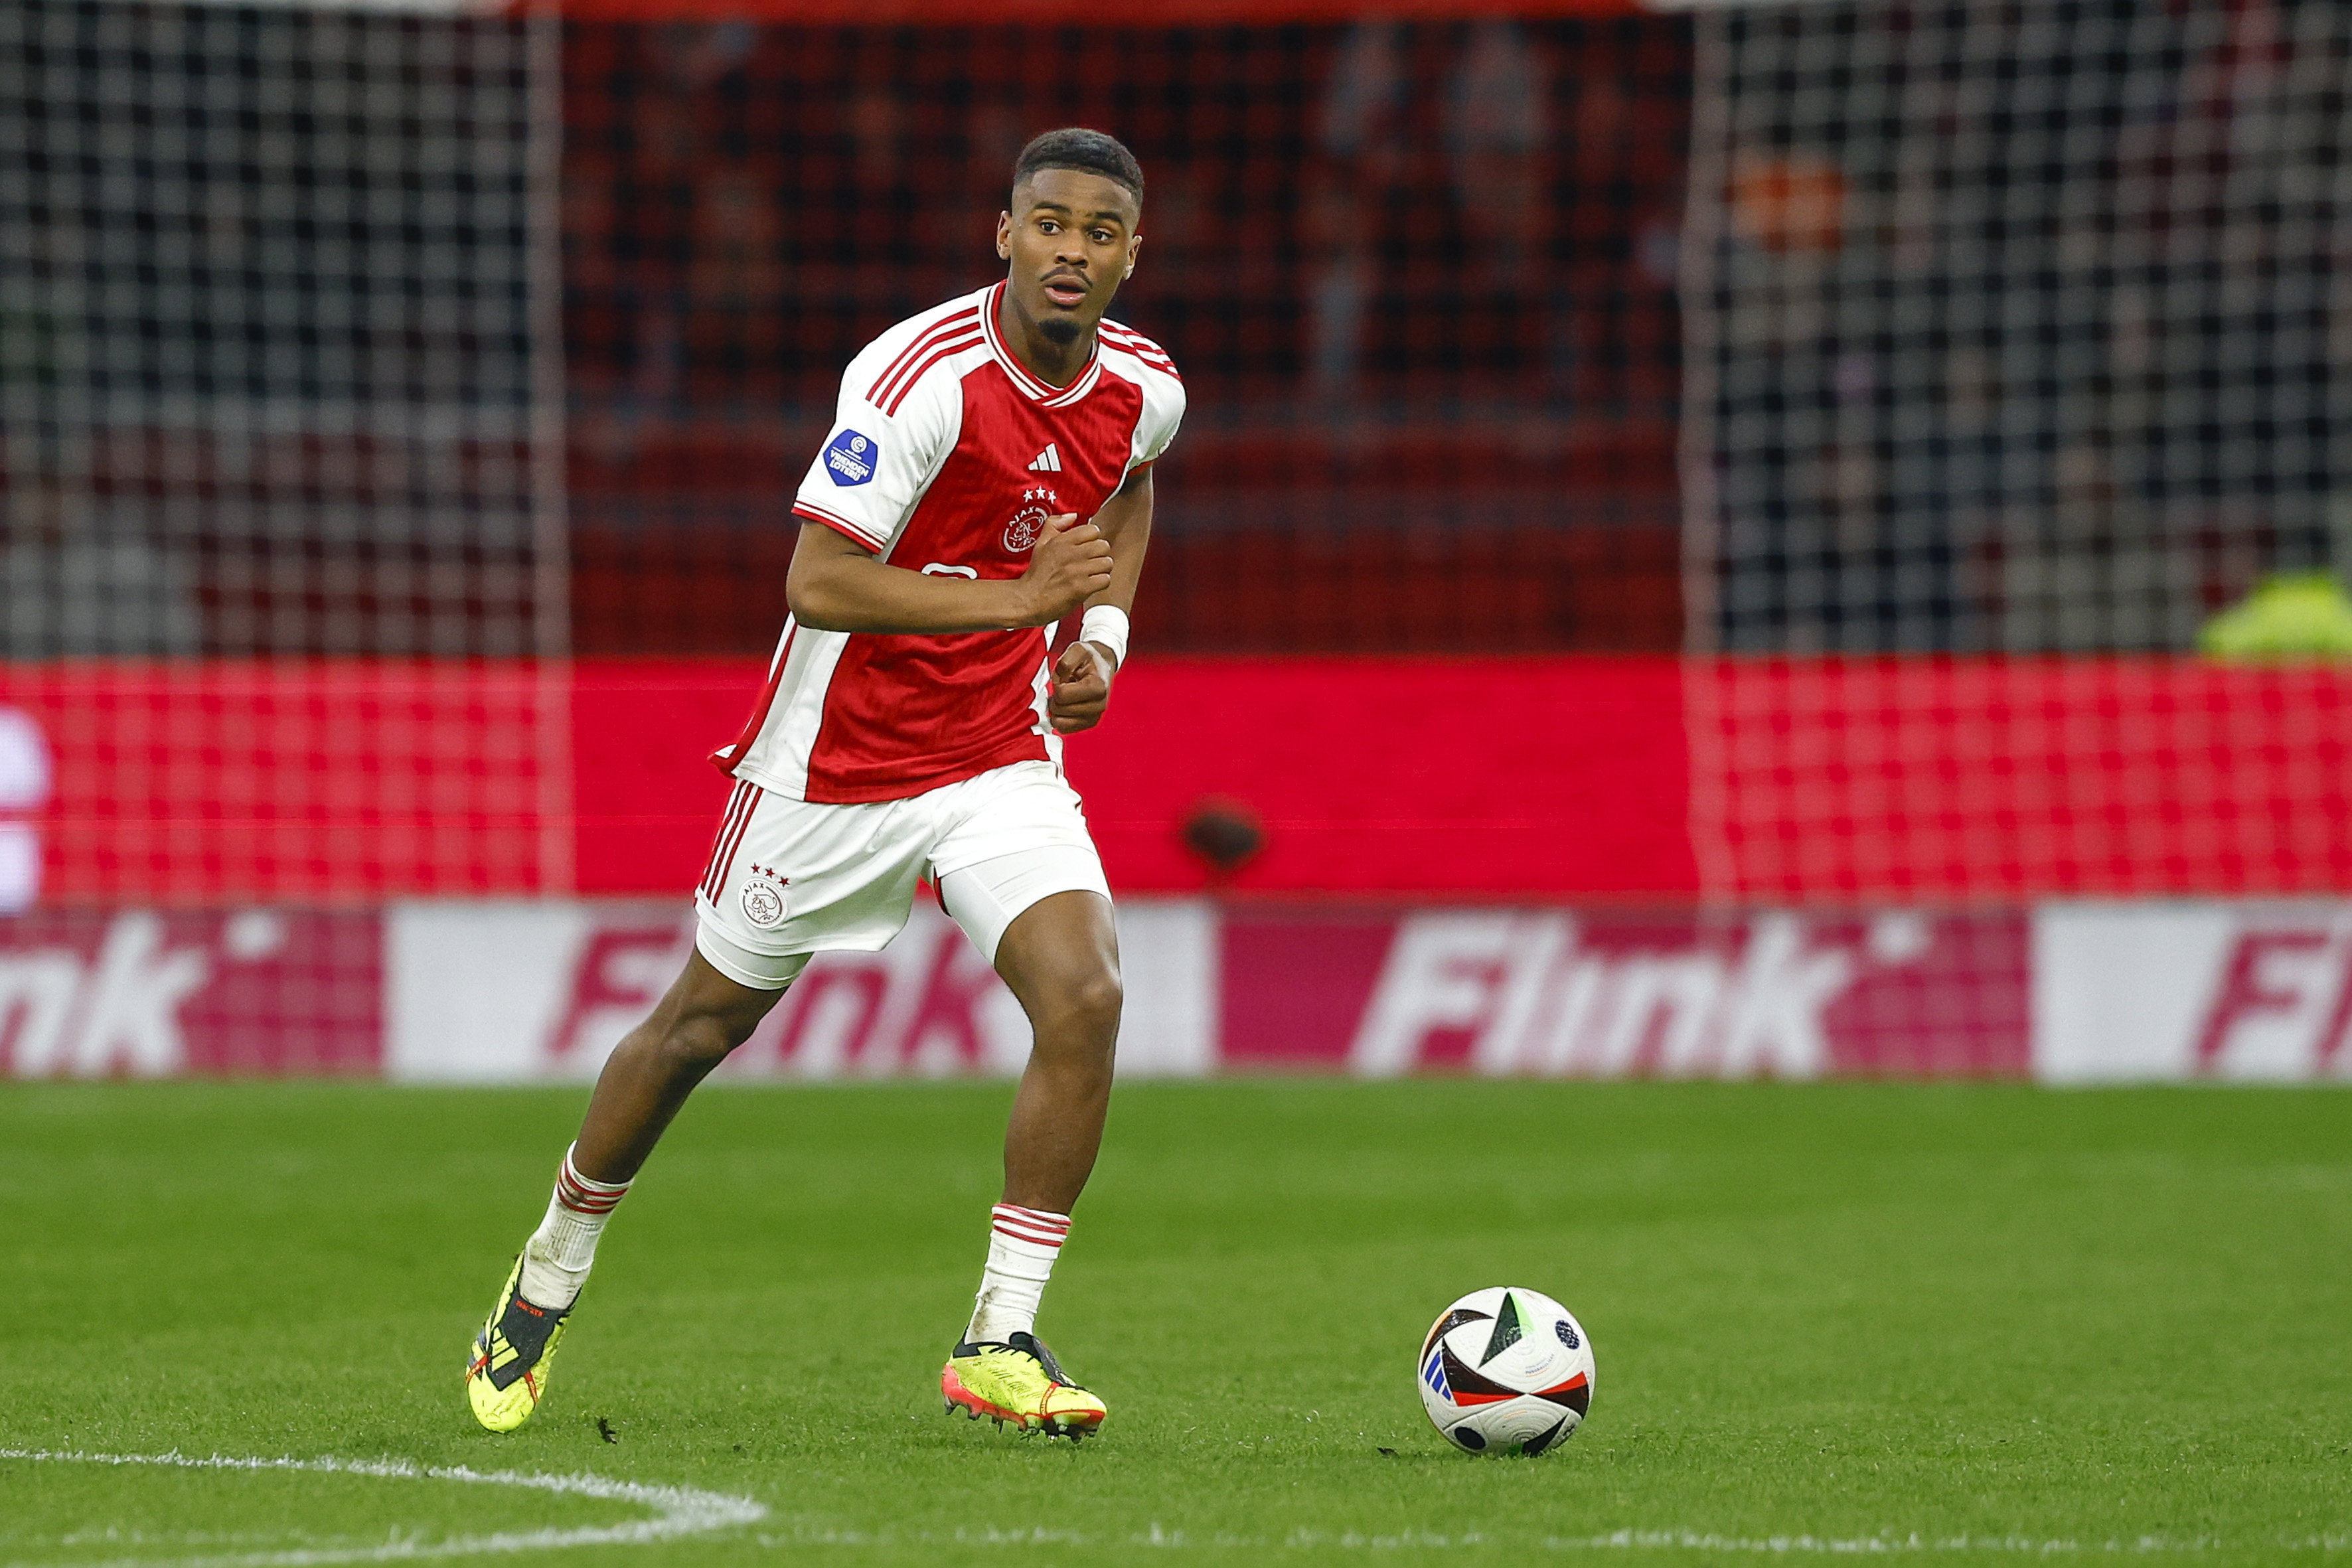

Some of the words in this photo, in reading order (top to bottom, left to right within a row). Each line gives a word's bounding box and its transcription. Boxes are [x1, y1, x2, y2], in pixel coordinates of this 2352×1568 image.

[830, 449, 869, 477] VRIENDEN
[1008, 506, 1034, 527] AJAX
[744, 882, 765, 895] AJAX
[544, 926, 1016, 1070] Fnk
[1351, 906, 1852, 1077] Flink
